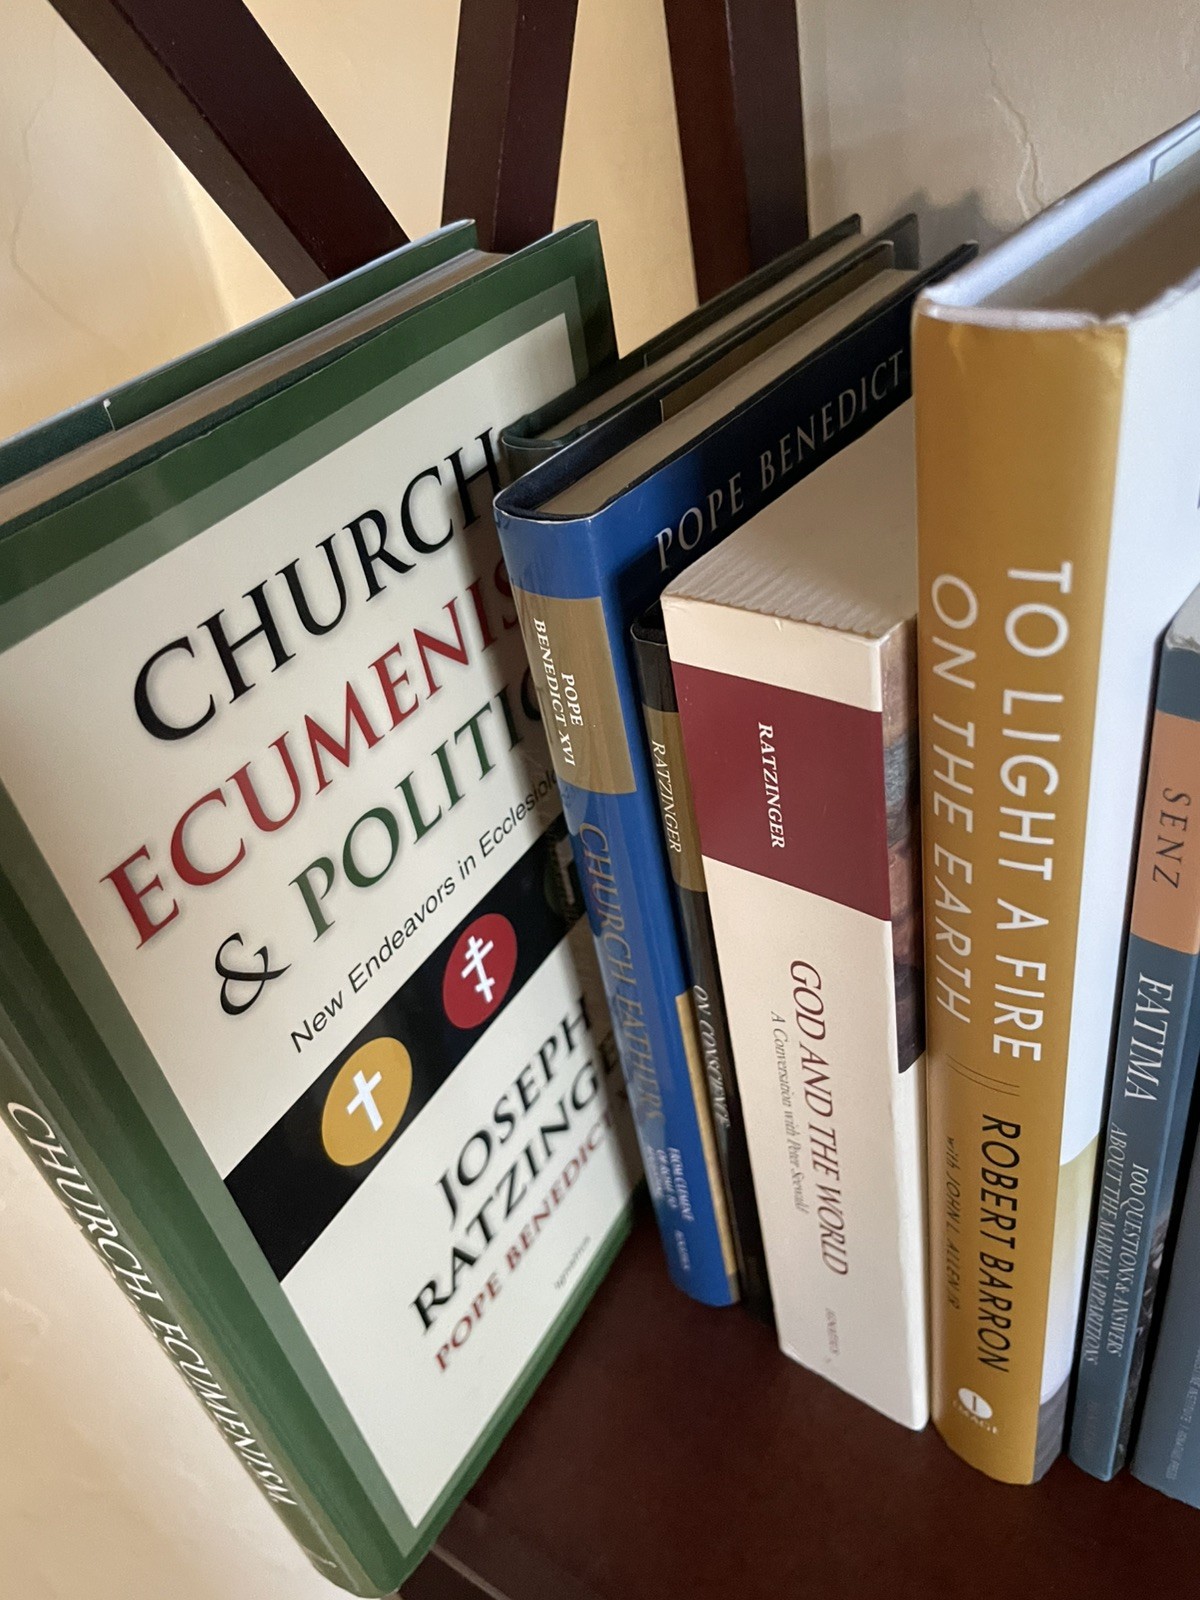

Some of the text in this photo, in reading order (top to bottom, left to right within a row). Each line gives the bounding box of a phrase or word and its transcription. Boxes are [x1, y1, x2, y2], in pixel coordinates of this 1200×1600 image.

[654, 349, 904, 572] POPE BENEDICT
[133, 427, 501, 741] CHURCH
[533, 617, 577, 767] BENEDICT XVI
[561, 672, 584, 727] POPE
[651, 738, 683, 854] RATZINGER
[758, 722, 785, 848] RATZINGER
[931, 573, 977, 1024] ON THE EARTH
[993, 560, 1073, 1062] TO LIGHT A FIRE
[1152, 787, 1191, 889] SENZ
[214, 932, 292, 1016] &
[290, 991, 344, 1053] New
[347, 876, 456, 994] Endeavors
[457, 854, 477, 880] in
[579, 822, 664, 1121] CHURCH FATHERS
[693, 985, 711, 1015] ON
[790, 959, 826, 1041] GOD
[771, 1010, 786, 1023] A
[1124, 971, 1175, 1102] FATIMA
[435, 996, 592, 1231] JOSEPH
[773, 1026, 796, 1108] Conversation
[799, 1041, 834, 1118] AND
[784, 1109, 801, 1138] with
[808, 1121, 840, 1181] THE
[946, 1136, 961, 1170] with
[815, 1183, 849, 1276] WORLD
[946, 1170, 961, 1224] JOHN
[977, 1113, 1022, 1373] ROBERT BARRON
[1084, 1122, 1128, 1365] ABOUT THE MARIAN APPARITIONS
[1117, 1196, 1146, 1286] QUESTIONS
[434, 1272, 502, 1372] POPE
[1106, 1292, 1129, 1357] ANSWERS
[1115, 1282, 1130, 1293] &
